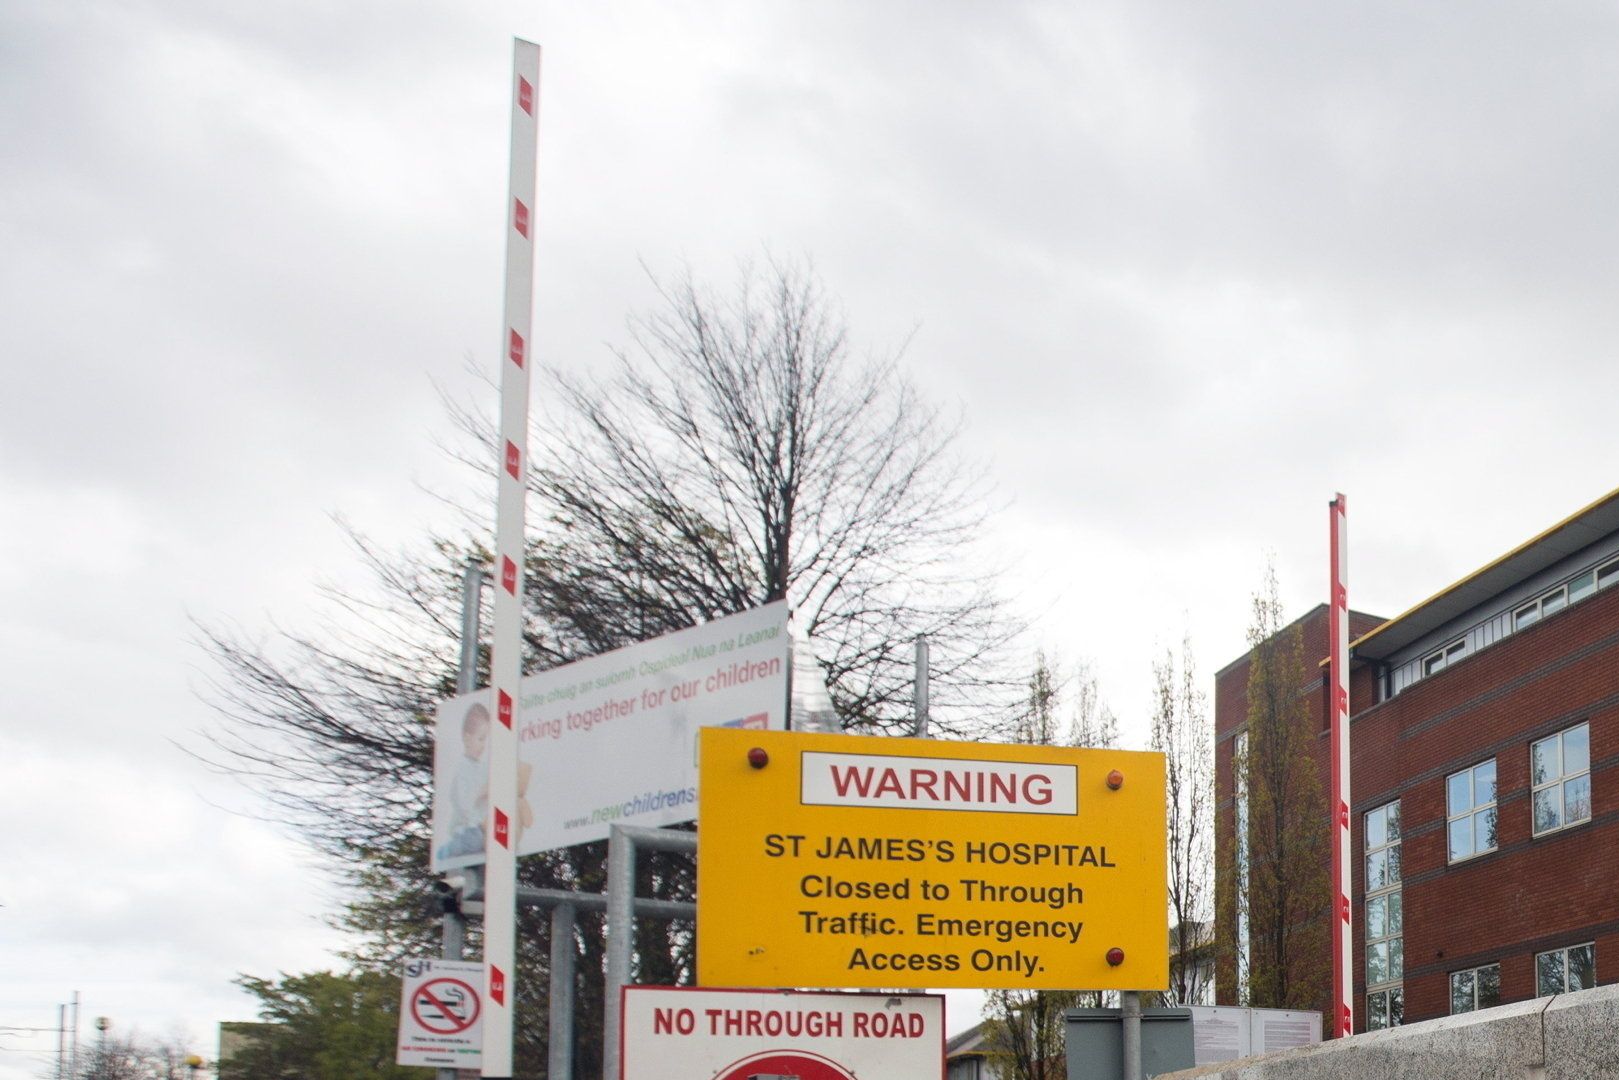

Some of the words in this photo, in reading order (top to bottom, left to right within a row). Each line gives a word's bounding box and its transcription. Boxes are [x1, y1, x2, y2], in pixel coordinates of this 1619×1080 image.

[520, 718, 561, 742] rking
[566, 697, 637, 731] together
[641, 688, 666, 710] for
[671, 680, 700, 702] our
[705, 656, 780, 693] children
[830, 764, 1053, 806] WARNING
[563, 787, 697, 829] www.newchildrens
[764, 834, 806, 858] ST
[816, 836, 956, 862] JAMES'S
[966, 842, 1116, 868] HOSPITAL
[800, 875, 910, 900] Closed
[920, 880, 950, 901] to
[960, 880, 1084, 909] Through
[798, 911, 904, 935] Traffic.
[917, 914, 1083, 944] Emergency
[848, 948, 960, 972] Access
[971, 950, 1045, 978] Only.
[654, 1008, 696, 1036] NO
[705, 1009, 843, 1037] THROUGH
[853, 1012, 925, 1038] ROAD
